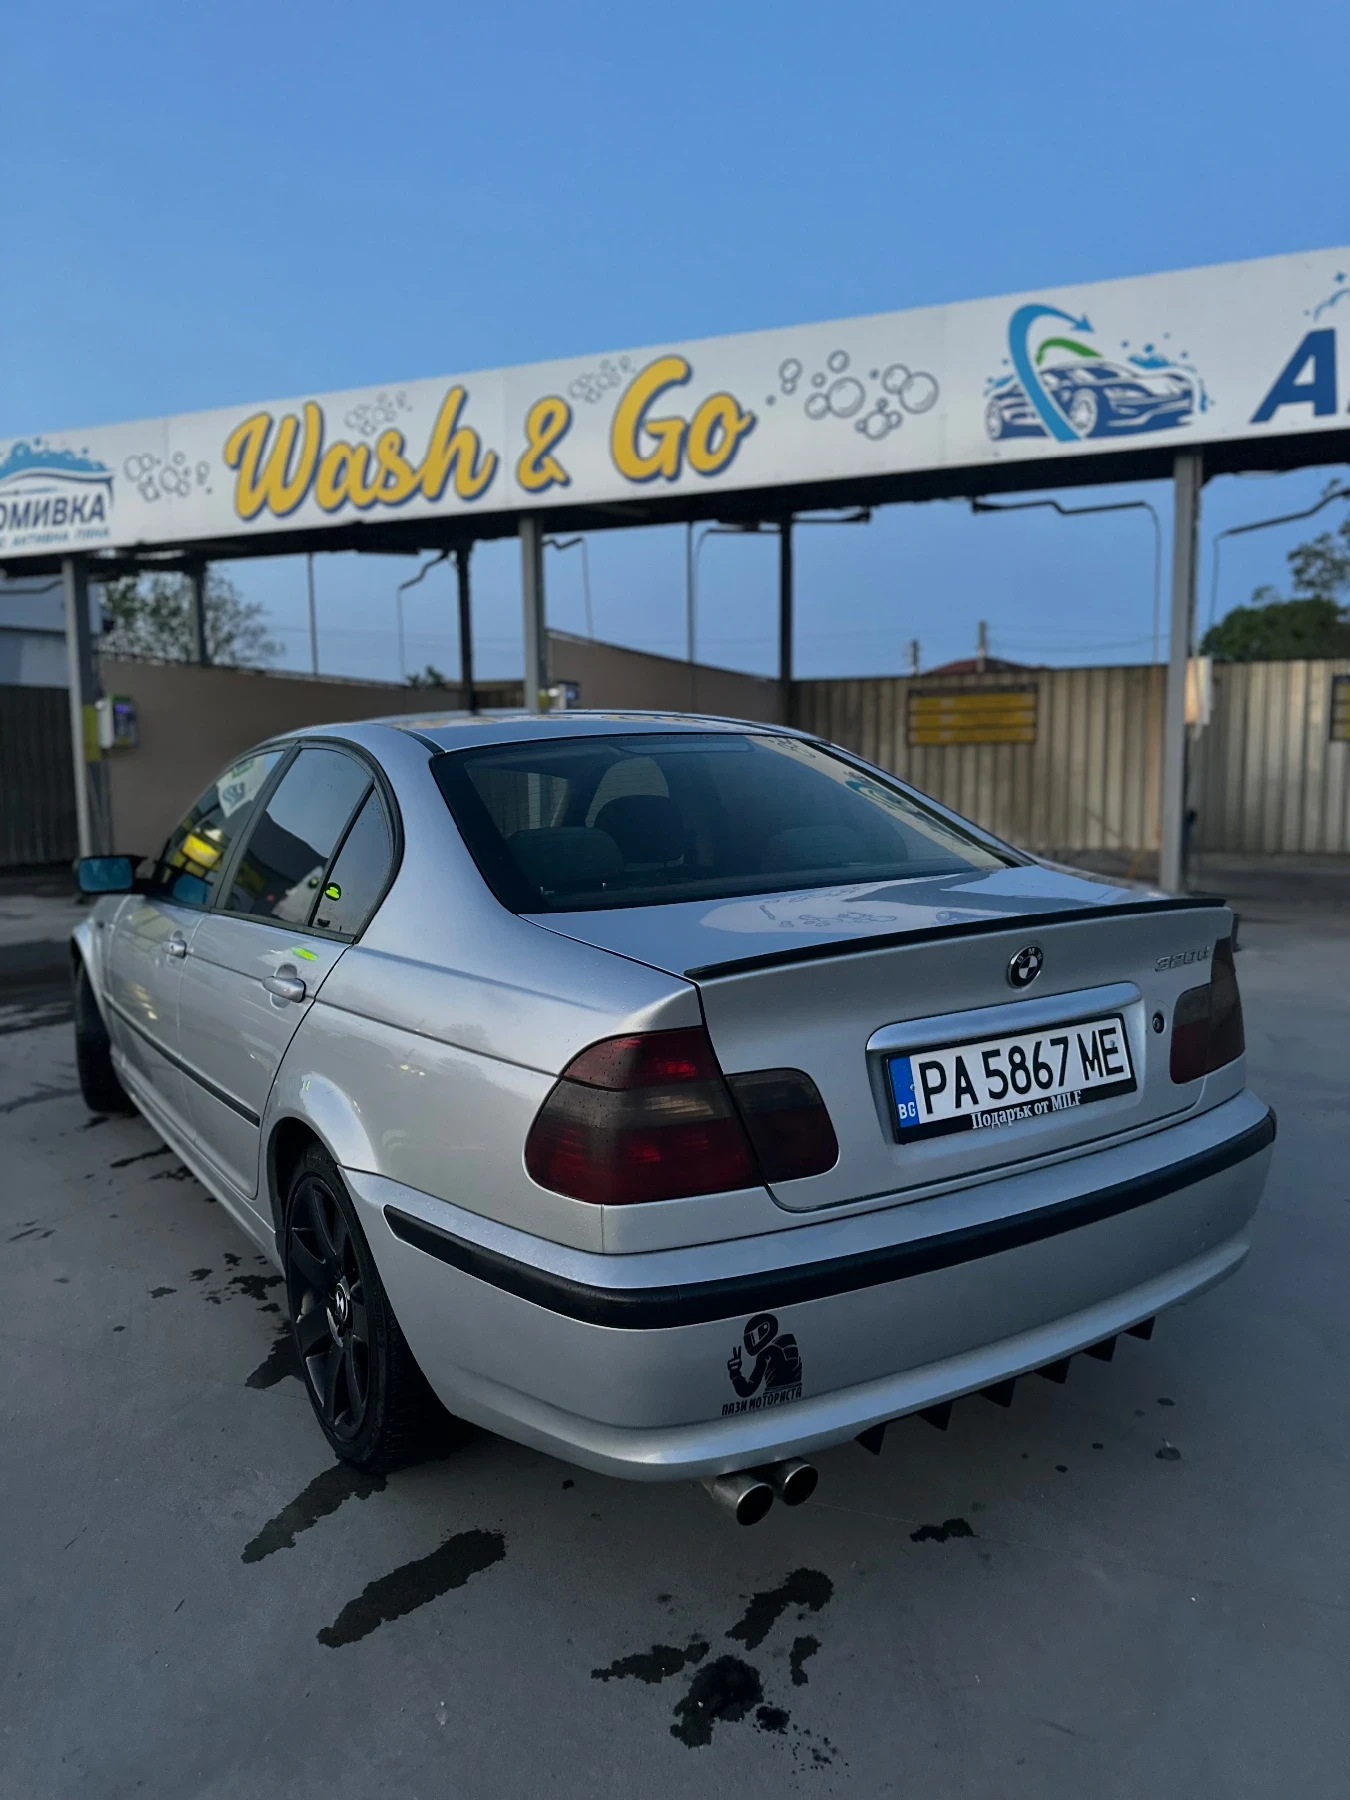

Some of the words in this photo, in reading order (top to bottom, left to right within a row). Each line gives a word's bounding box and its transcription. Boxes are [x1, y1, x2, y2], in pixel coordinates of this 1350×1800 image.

[1249, 327, 1350, 424] А
[223, 384, 499, 521] Wash
[515, 394, 573, 493] &
[610, 354, 758, 484] Go
[898, 1102, 917, 1120] BG
[970, 1105, 1032, 1130] Подарък
[1034, 1101, 1049, 1115] от
[1050, 1089, 1082, 1113] MILF
[721, 1400, 747, 1416] ПАЗИ
[748, 1386, 803, 1411] МОТОРИСТА
